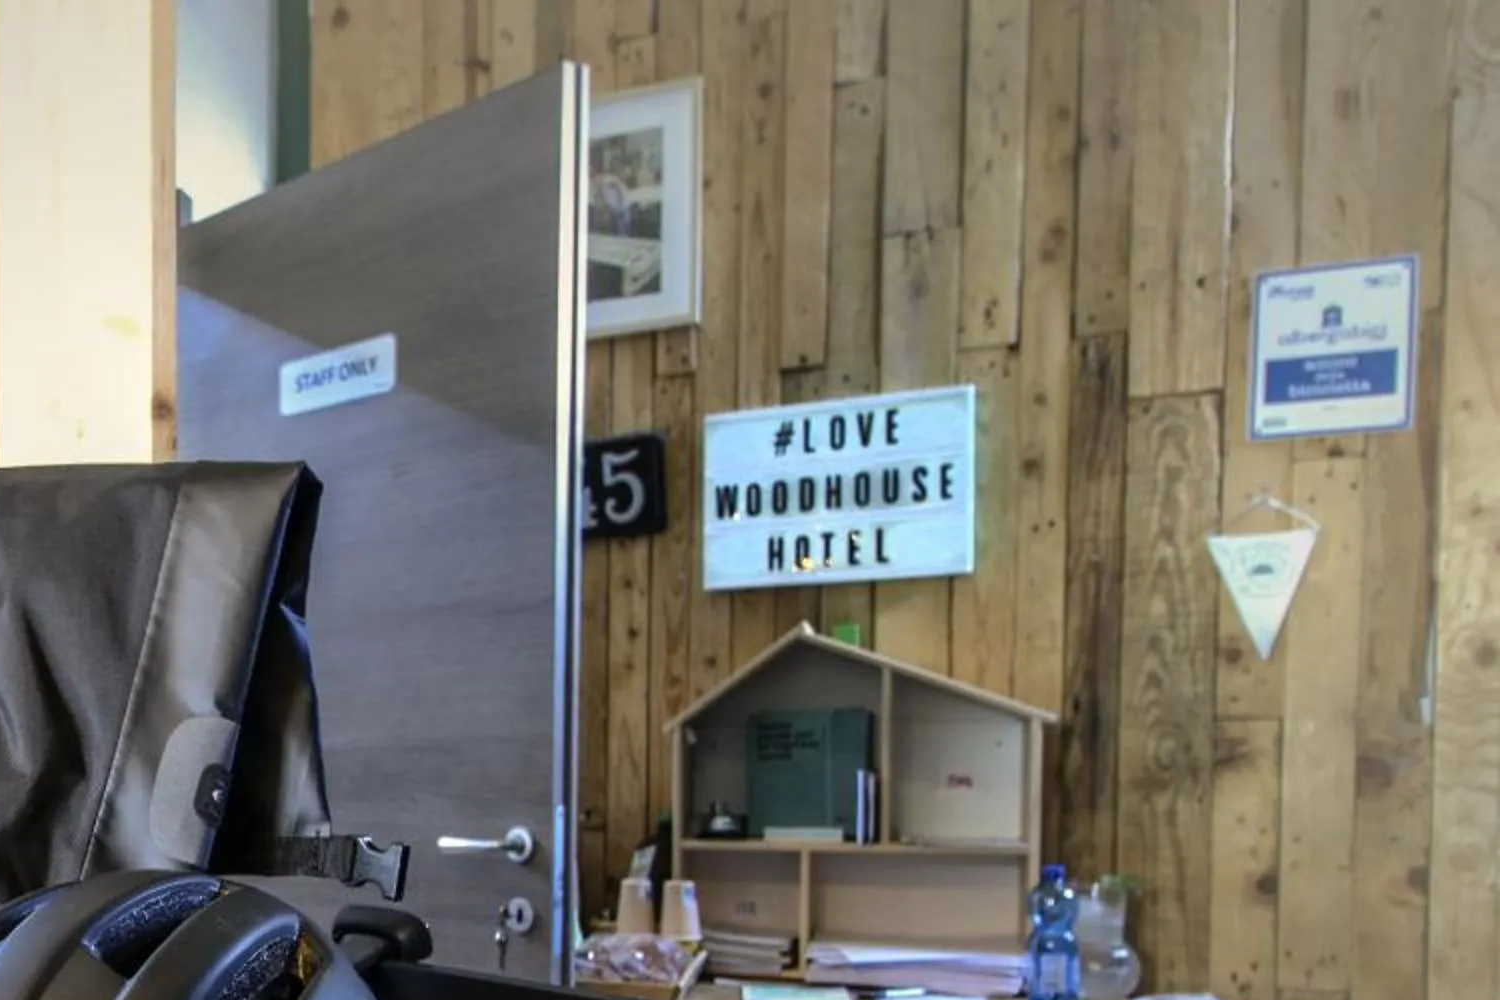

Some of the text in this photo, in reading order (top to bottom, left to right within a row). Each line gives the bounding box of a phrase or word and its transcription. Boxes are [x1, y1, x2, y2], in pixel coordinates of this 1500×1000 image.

[294, 354, 380, 394] STAFF ONLY
[772, 408, 900, 458] #LOVE
[714, 462, 955, 521] WOODHOUSE
[766, 527, 891, 573] HOTEL
